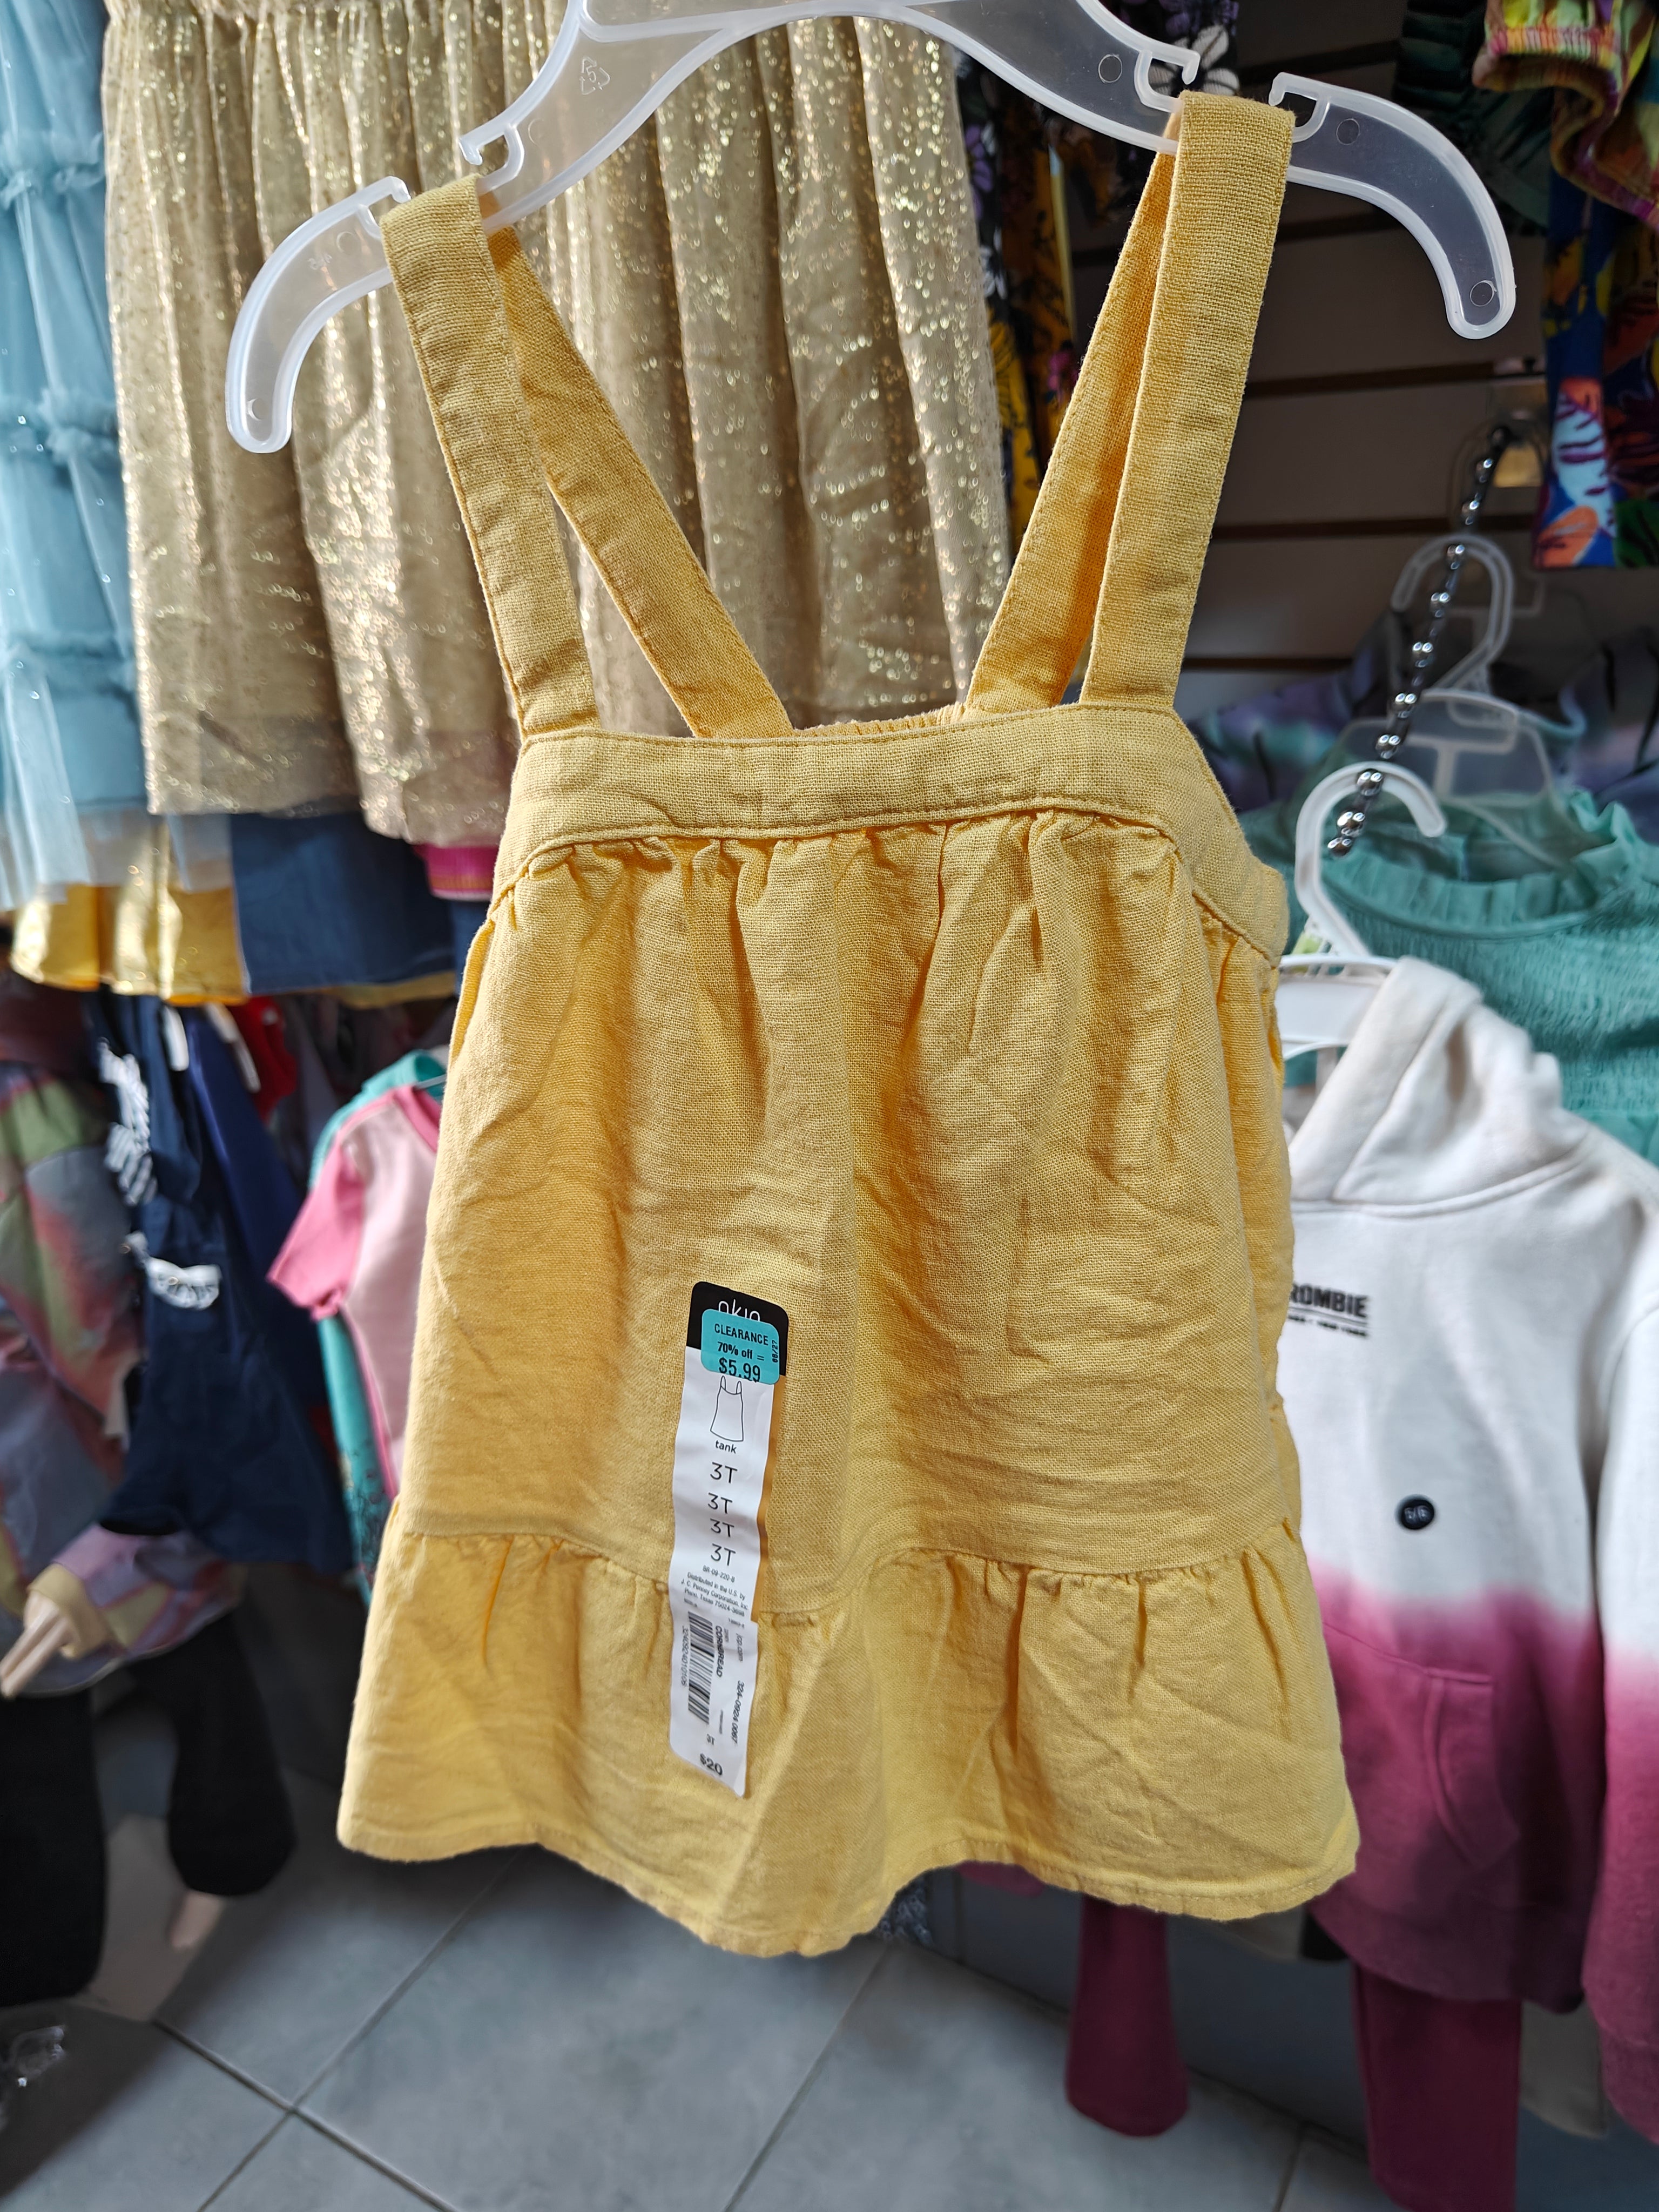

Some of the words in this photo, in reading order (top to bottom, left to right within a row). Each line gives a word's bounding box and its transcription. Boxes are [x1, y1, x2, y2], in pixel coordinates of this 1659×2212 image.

[714, 1323, 768, 1346] CLEARANCE
[718, 1341, 738, 1356] 70%
[741, 1348, 753, 1359] off
[719, 1357, 760, 1382] $5.99
[714, 1440, 737, 1454] tank
[710, 1461, 738, 1484] 3T
[707, 1492, 733, 1514] 3T
[710, 1518, 734, 1538] 3T
[711, 1543, 736, 1566] 3T
[739, 1593, 745, 1601] by
[716, 1625, 724, 1677] CORNBREAD
[700, 1753, 723, 1776] $20
